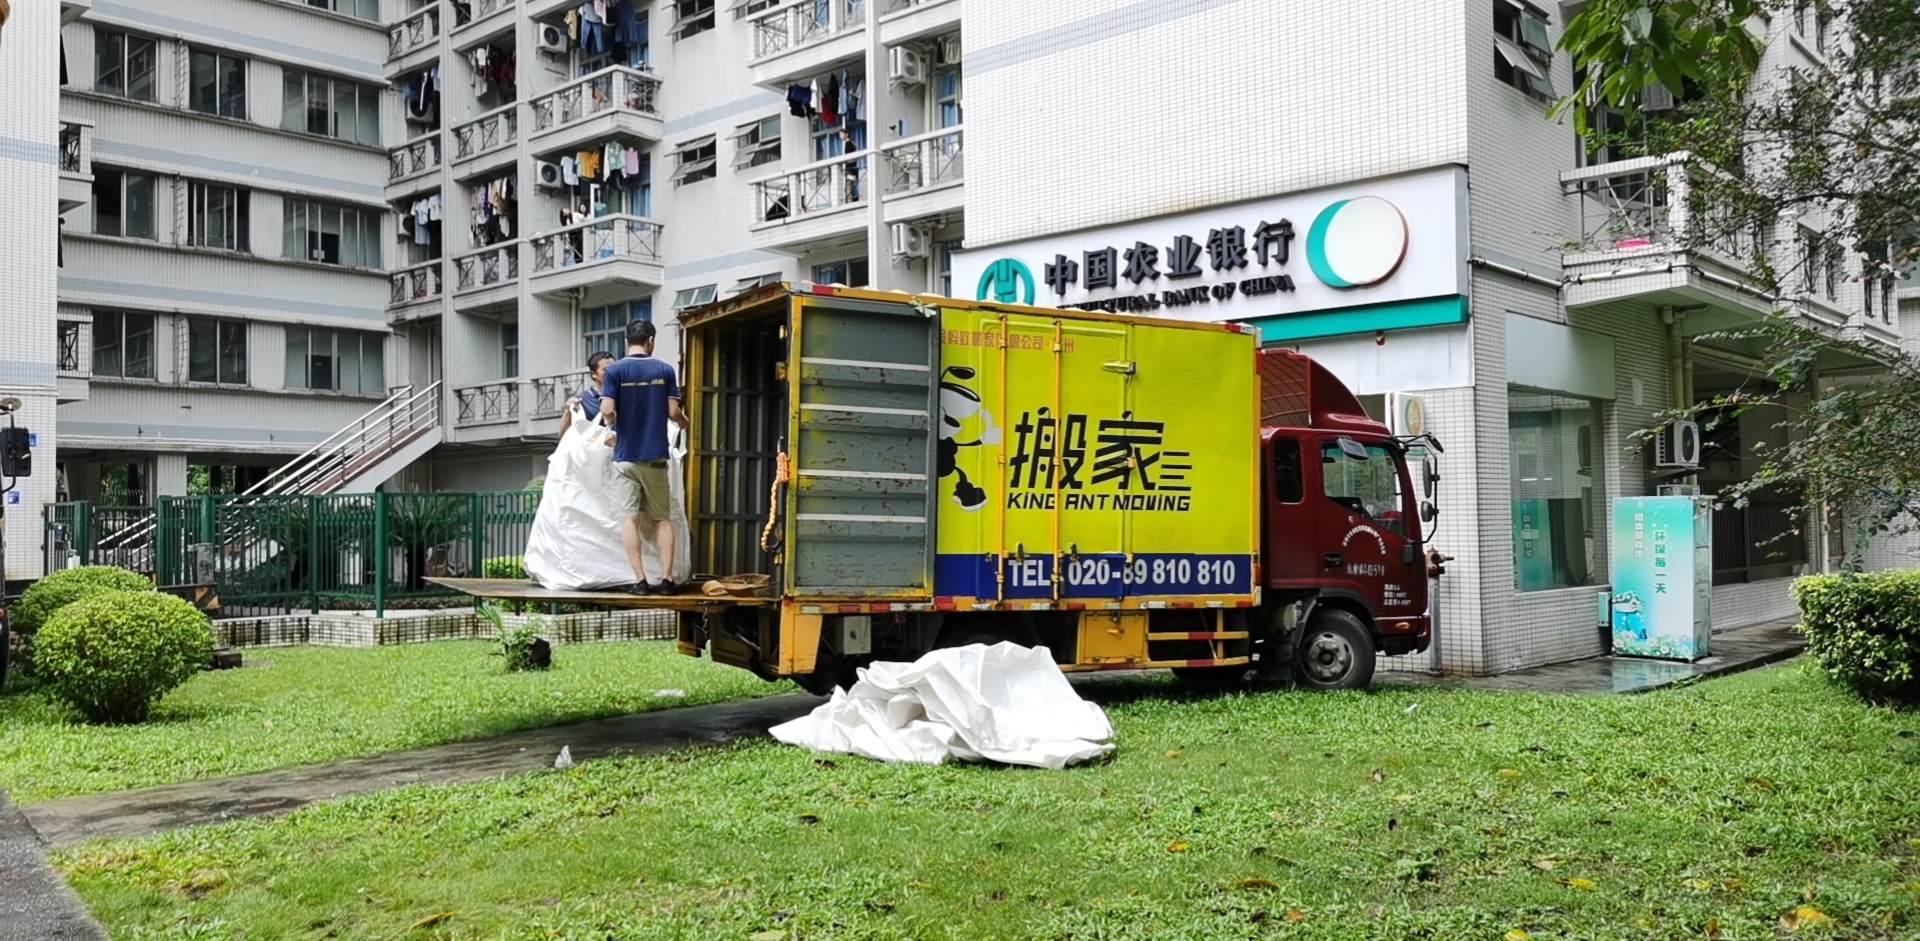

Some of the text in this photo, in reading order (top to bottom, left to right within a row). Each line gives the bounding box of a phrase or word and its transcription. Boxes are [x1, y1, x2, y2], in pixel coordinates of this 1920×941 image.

[1044, 218, 1296, 296] 中国农业银行
[1057, 274, 1296, 313] ULTURAL BANK OF CHINA
[1009, 406, 1166, 491] 搬家
[1065, 494, 1109, 510] ANT
[1068, 559, 1147, 585] 020-89
[1152, 559, 1191, 584] 810
[1197, 560, 1235, 585] 810
[1654, 530, 1667, 594] 环保每一天
